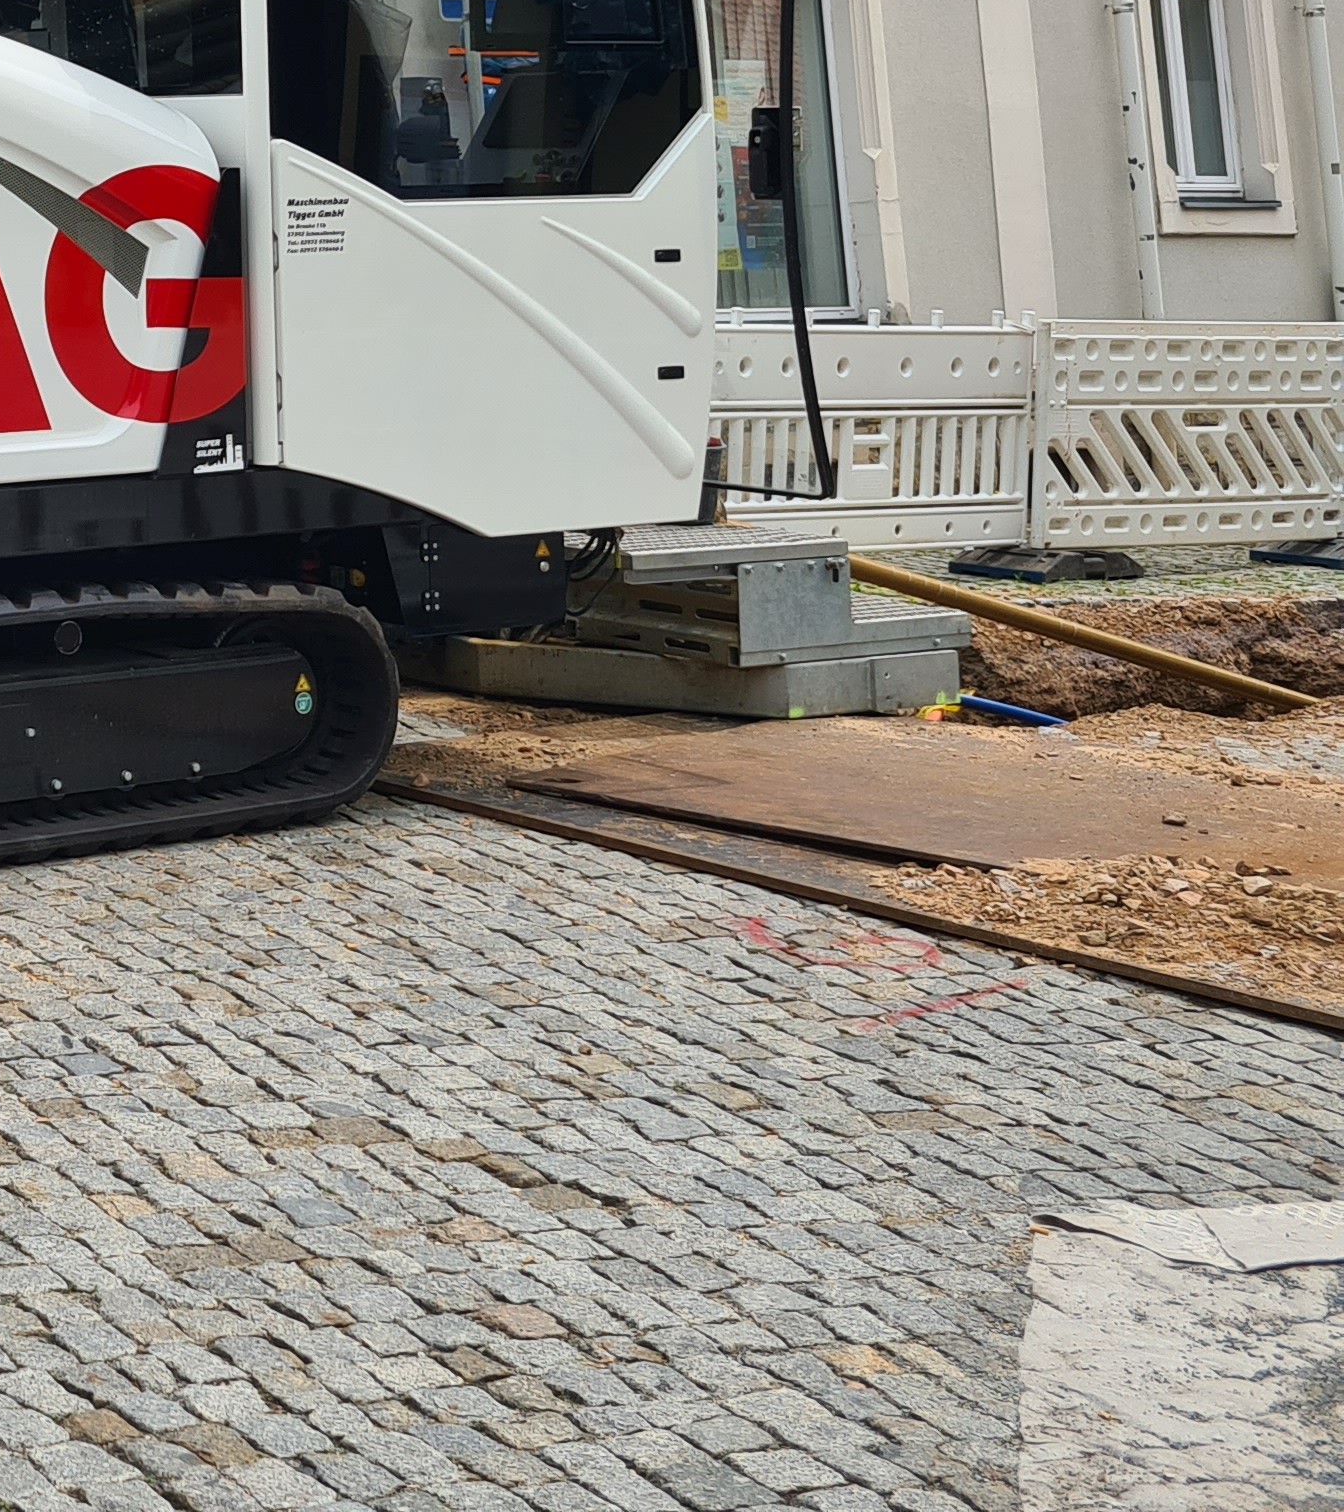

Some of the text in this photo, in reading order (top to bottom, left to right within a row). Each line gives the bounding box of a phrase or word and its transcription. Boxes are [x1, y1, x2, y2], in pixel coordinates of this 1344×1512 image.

[287, 198, 349, 206] Maschinenbau
[288, 209, 344, 220] Tigges GmbH
